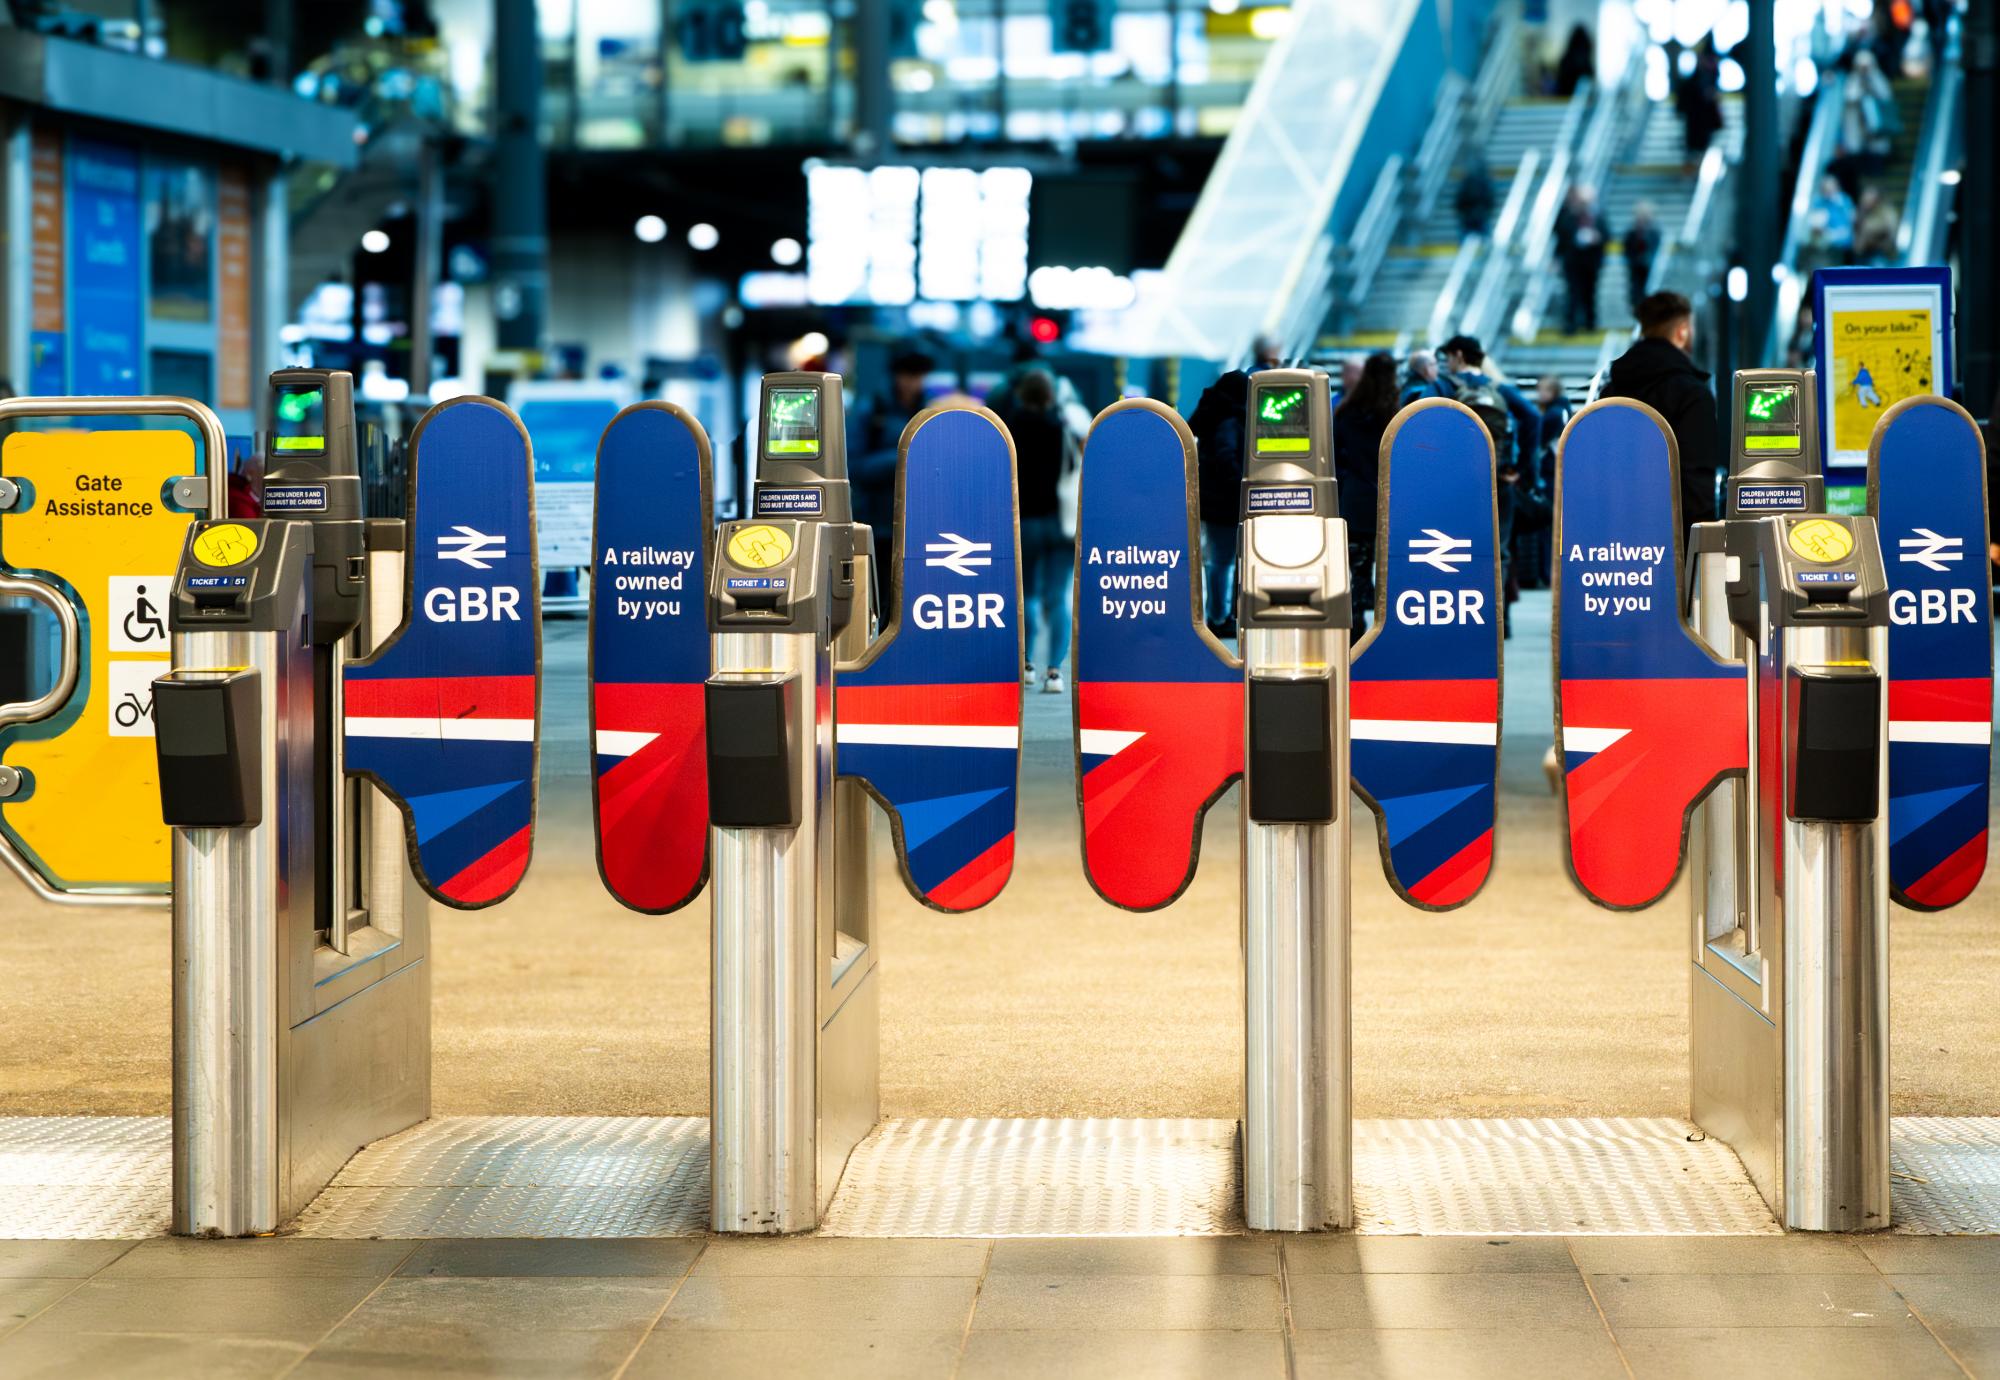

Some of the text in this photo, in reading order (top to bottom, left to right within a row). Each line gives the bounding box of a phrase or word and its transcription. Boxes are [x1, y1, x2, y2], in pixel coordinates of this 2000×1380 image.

[1844, 321, 1919, 336] On your bike?
[76, 475, 122, 491] Gate
[45, 499, 153, 516] Assistance
[604, 546, 695, 570] A railway
[1088, 545, 1181, 569] A railway
[1569, 542, 1665, 565] A railway
[191, 578, 220, 586] TICKET
[615, 571, 683, 590] owned
[730, 579, 785, 587] TICKET 52
[1099, 570, 1168, 590] owned
[1581, 567, 1653, 587] owned
[1801, 573, 1856, 581] TICKET 54
[423, 586, 521, 623] GBR
[618, 596, 680, 620] by you
[912, 593, 1006, 630] GBR
[1102, 595, 1166, 619] by you
[1395, 589, 1485, 626] GBR
[1584, 592, 1651, 616] by you
[1888, 588, 1978, 626] GBR
